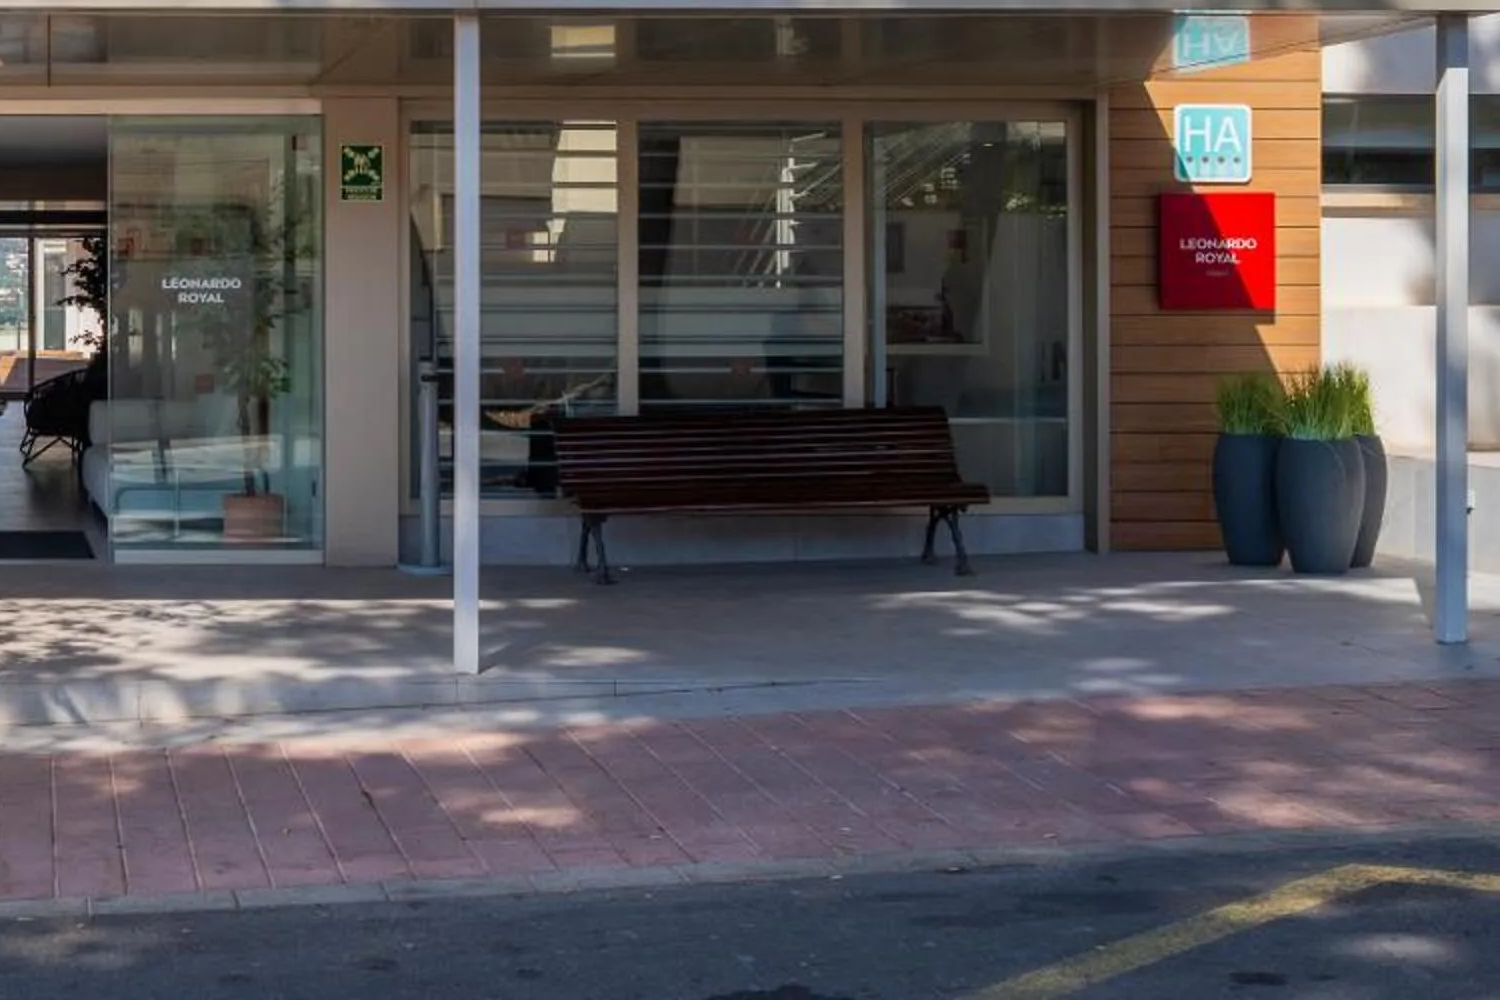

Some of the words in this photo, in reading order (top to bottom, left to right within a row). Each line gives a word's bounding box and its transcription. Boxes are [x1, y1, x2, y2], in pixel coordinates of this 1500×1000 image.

[1184, 115, 1242, 153] HA
[1179, 237, 1258, 250] LEONARDO
[1195, 251, 1242, 265] ROYAL
[161, 277, 242, 290] LEONARDO
[177, 291, 226, 304] ROYAL
